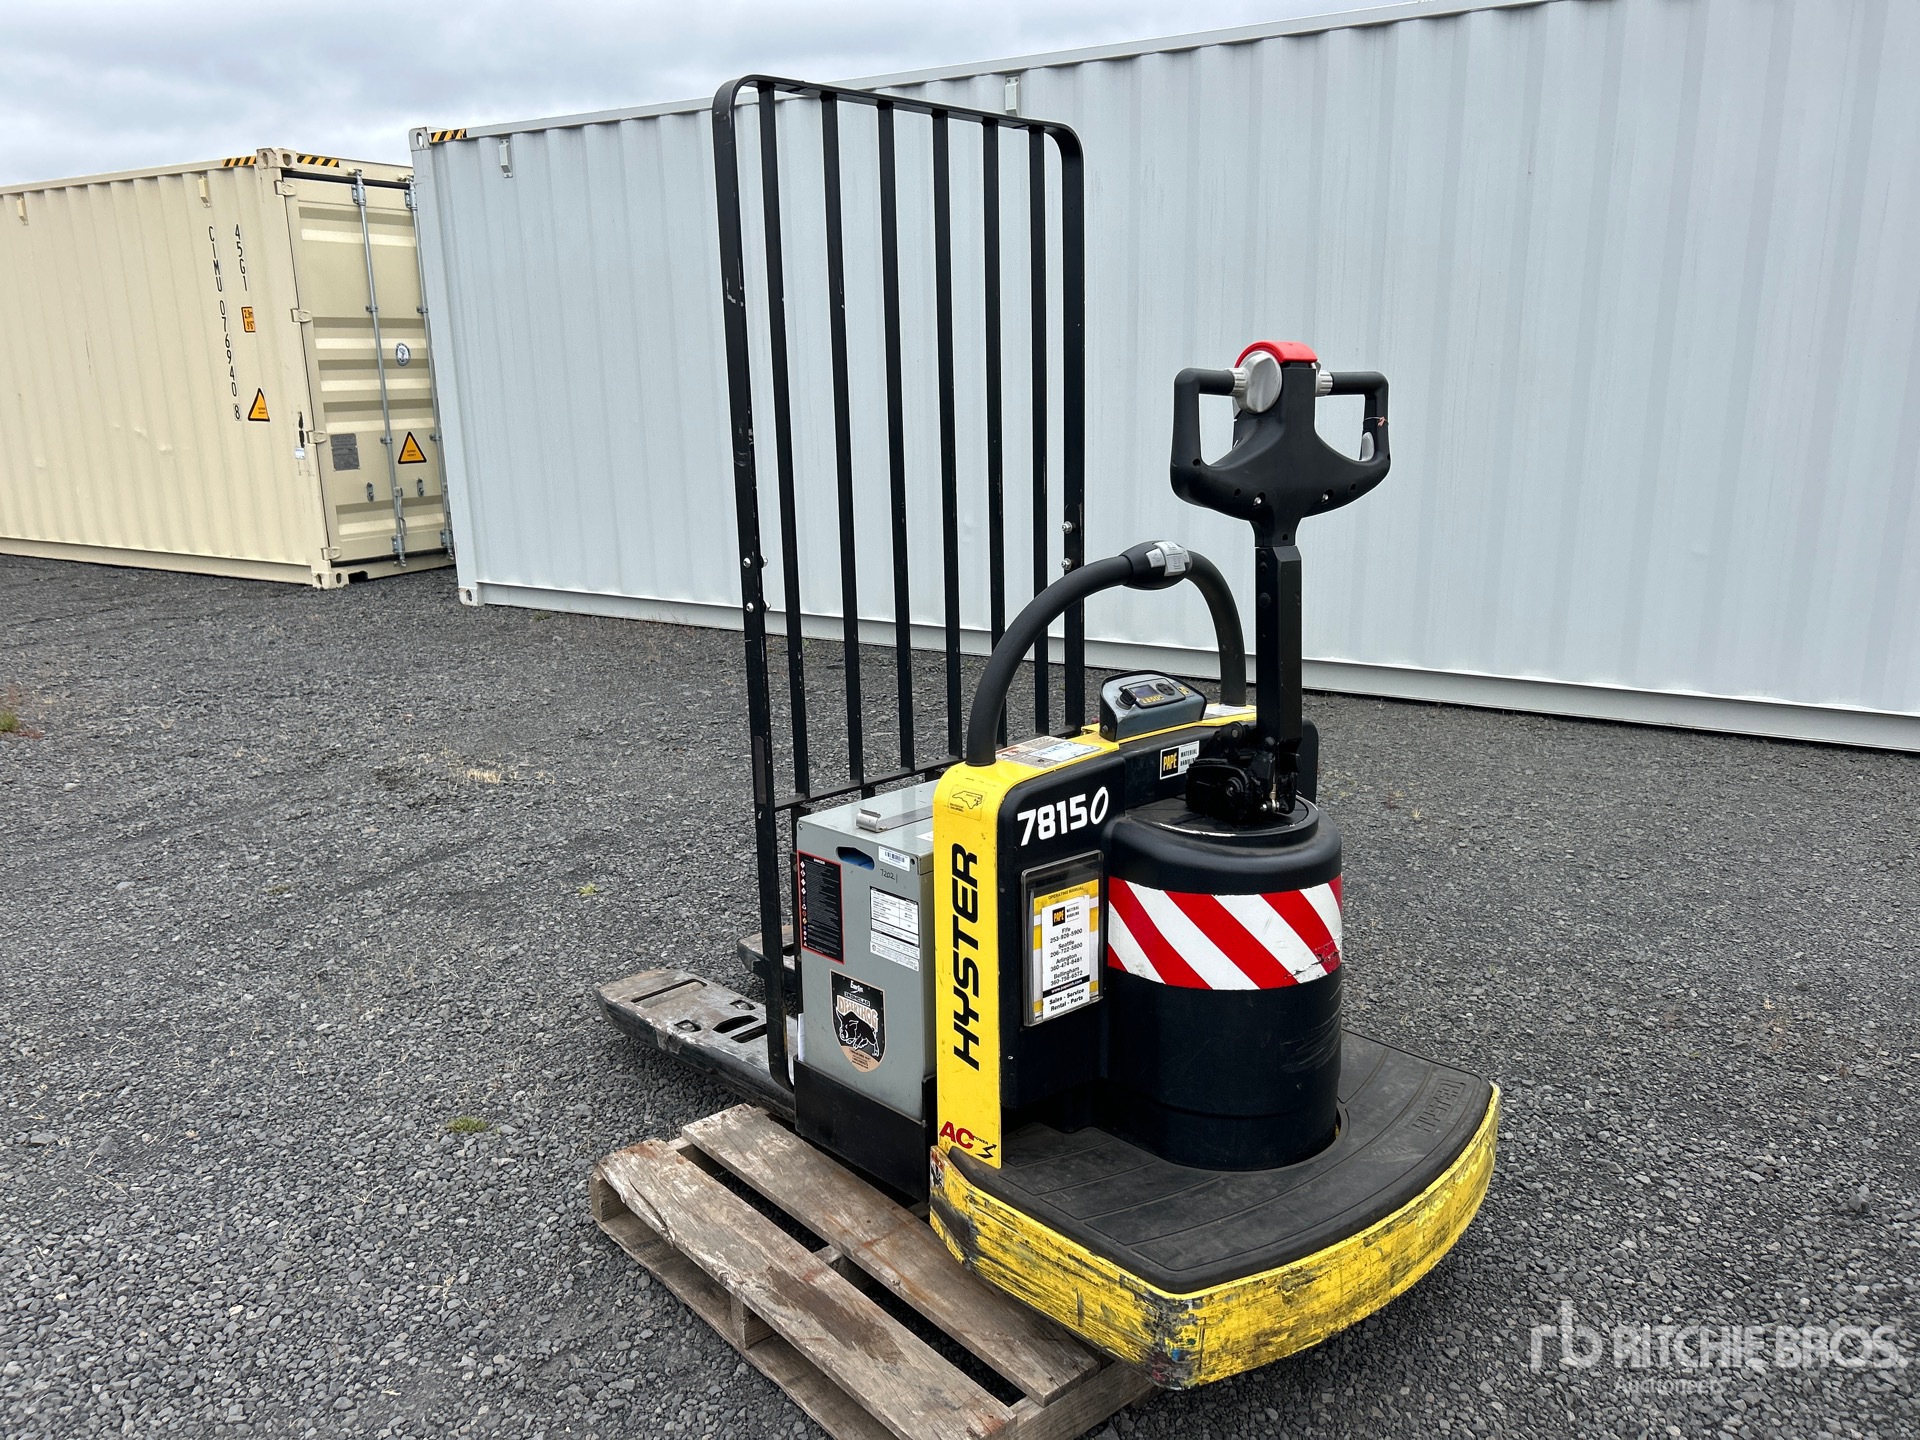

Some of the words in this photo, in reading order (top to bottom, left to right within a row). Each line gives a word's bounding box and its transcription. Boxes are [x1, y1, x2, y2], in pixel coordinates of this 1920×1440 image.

[235, 223, 248, 292] 45G1
[208, 225, 223, 293] CIMU
[219, 299, 237, 397] 076940
[1016, 785, 1109, 847] 78150
[951, 842, 980, 1072] HYSTER
[1058, 940, 1075, 950] Seattle
[1053, 966, 1080, 979] Bellingham
[1049, 996, 1063, 1005] Sales
[1066, 988, 1085, 999] Service
[1050, 1001, 1067, 1012] Rental
[1070, 995, 1084, 1004] Parts
[939, 1120, 975, 1149] AC
